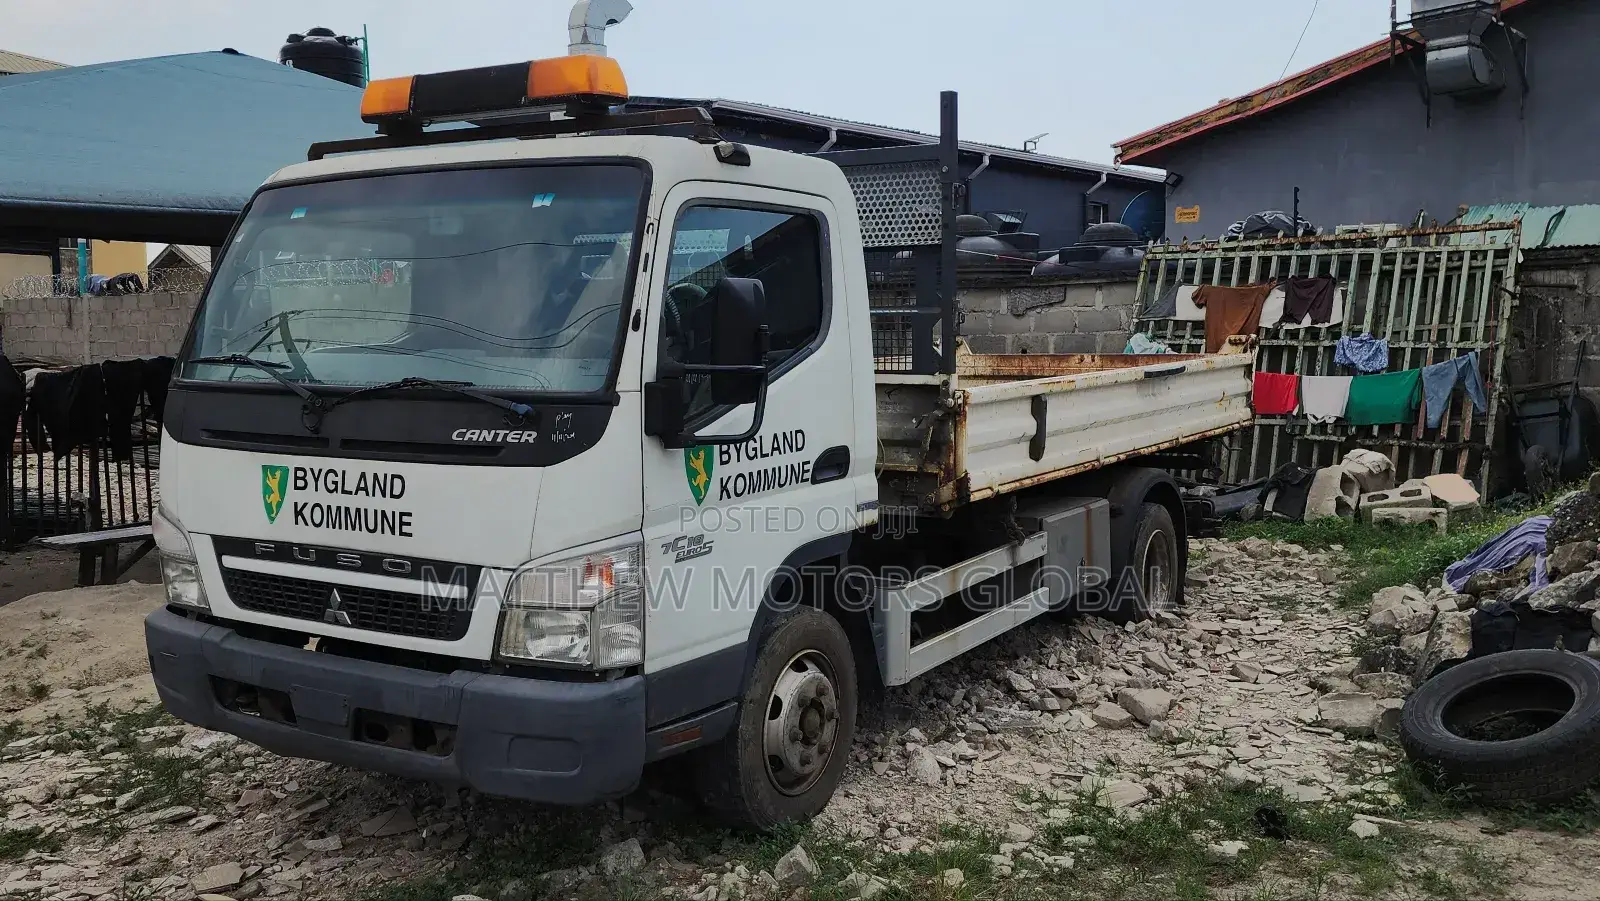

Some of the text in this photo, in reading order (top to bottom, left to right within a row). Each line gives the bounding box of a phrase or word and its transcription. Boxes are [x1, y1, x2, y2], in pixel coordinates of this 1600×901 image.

[451, 428, 538, 444] CANTER
[720, 428, 806, 466] BYGLAND
[293, 466, 406, 500] BYGLAND
[719, 460, 811, 502] KOMMUNE
[293, 501, 413, 538] KOMMUNE
[255, 542, 412, 574] FUSO
